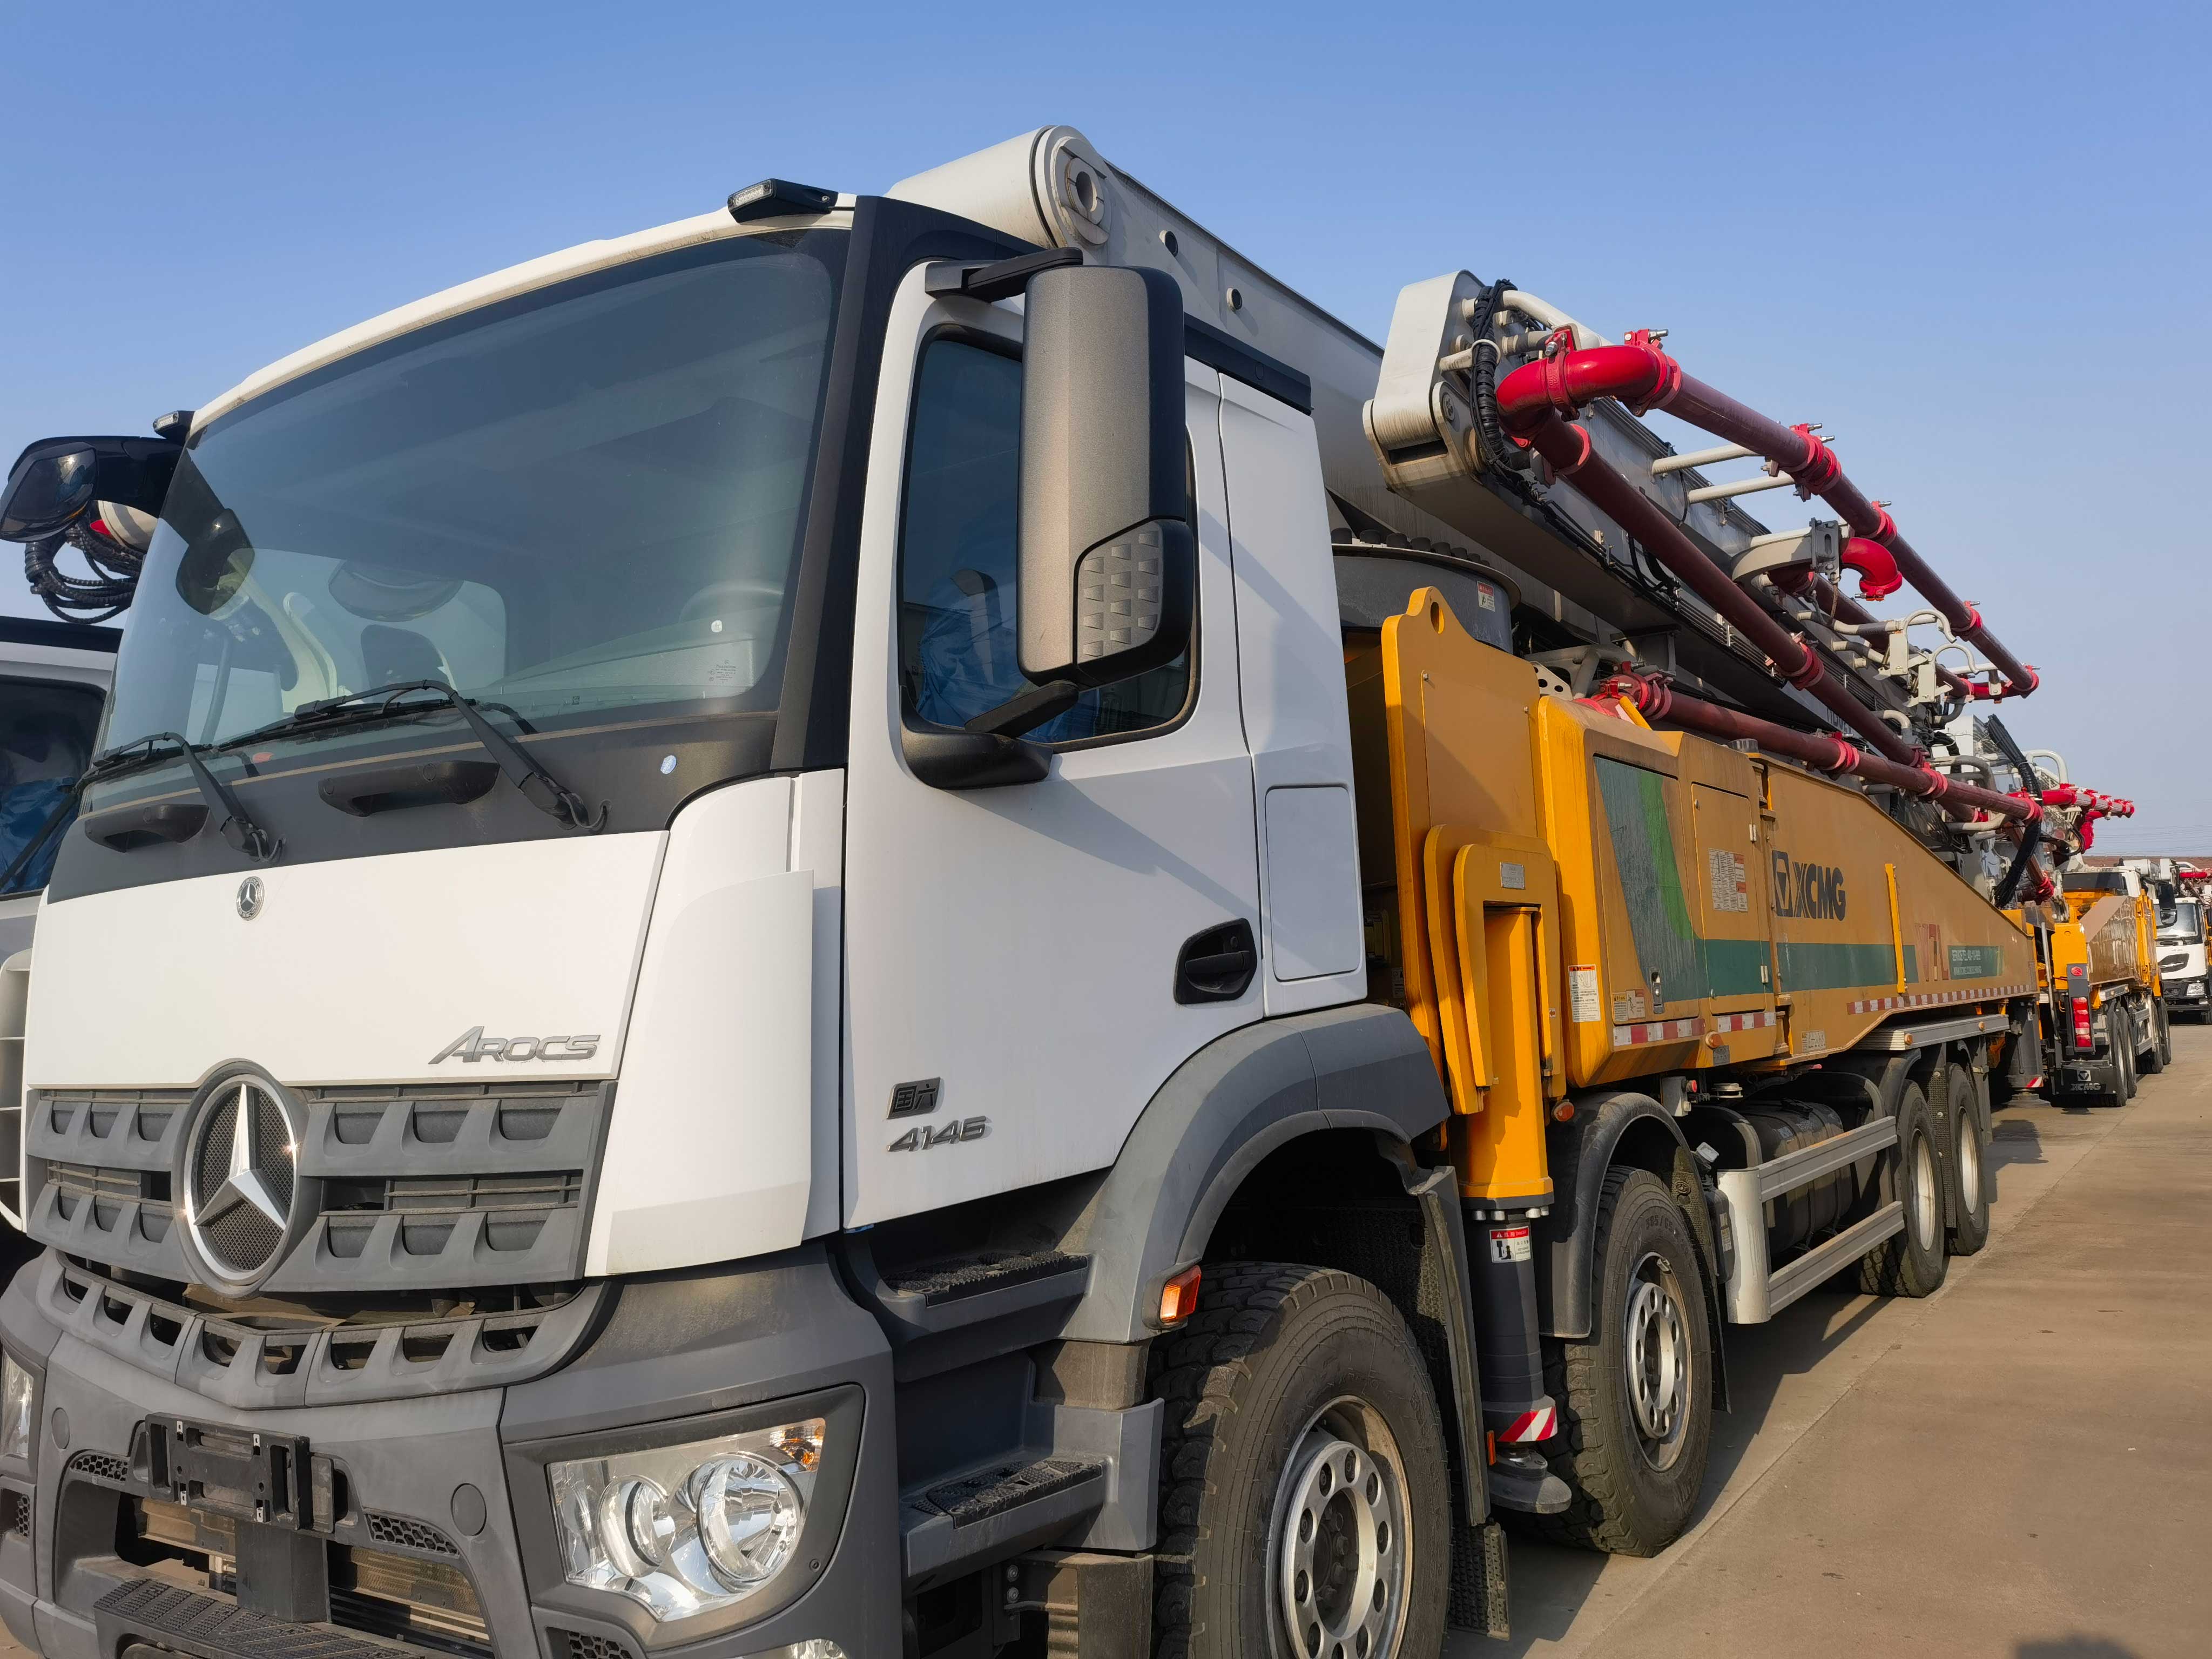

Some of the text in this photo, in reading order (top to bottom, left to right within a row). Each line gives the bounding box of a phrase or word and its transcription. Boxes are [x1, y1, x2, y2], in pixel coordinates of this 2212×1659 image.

[1792, 861, 1846, 921] XCMG
[428, 1026, 601, 1064] AROCS
[892, 1083, 937, 1114] 国六
[2070, 1082, 2101, 1091] XCMG
[887, 1115, 987, 1152] 4146
